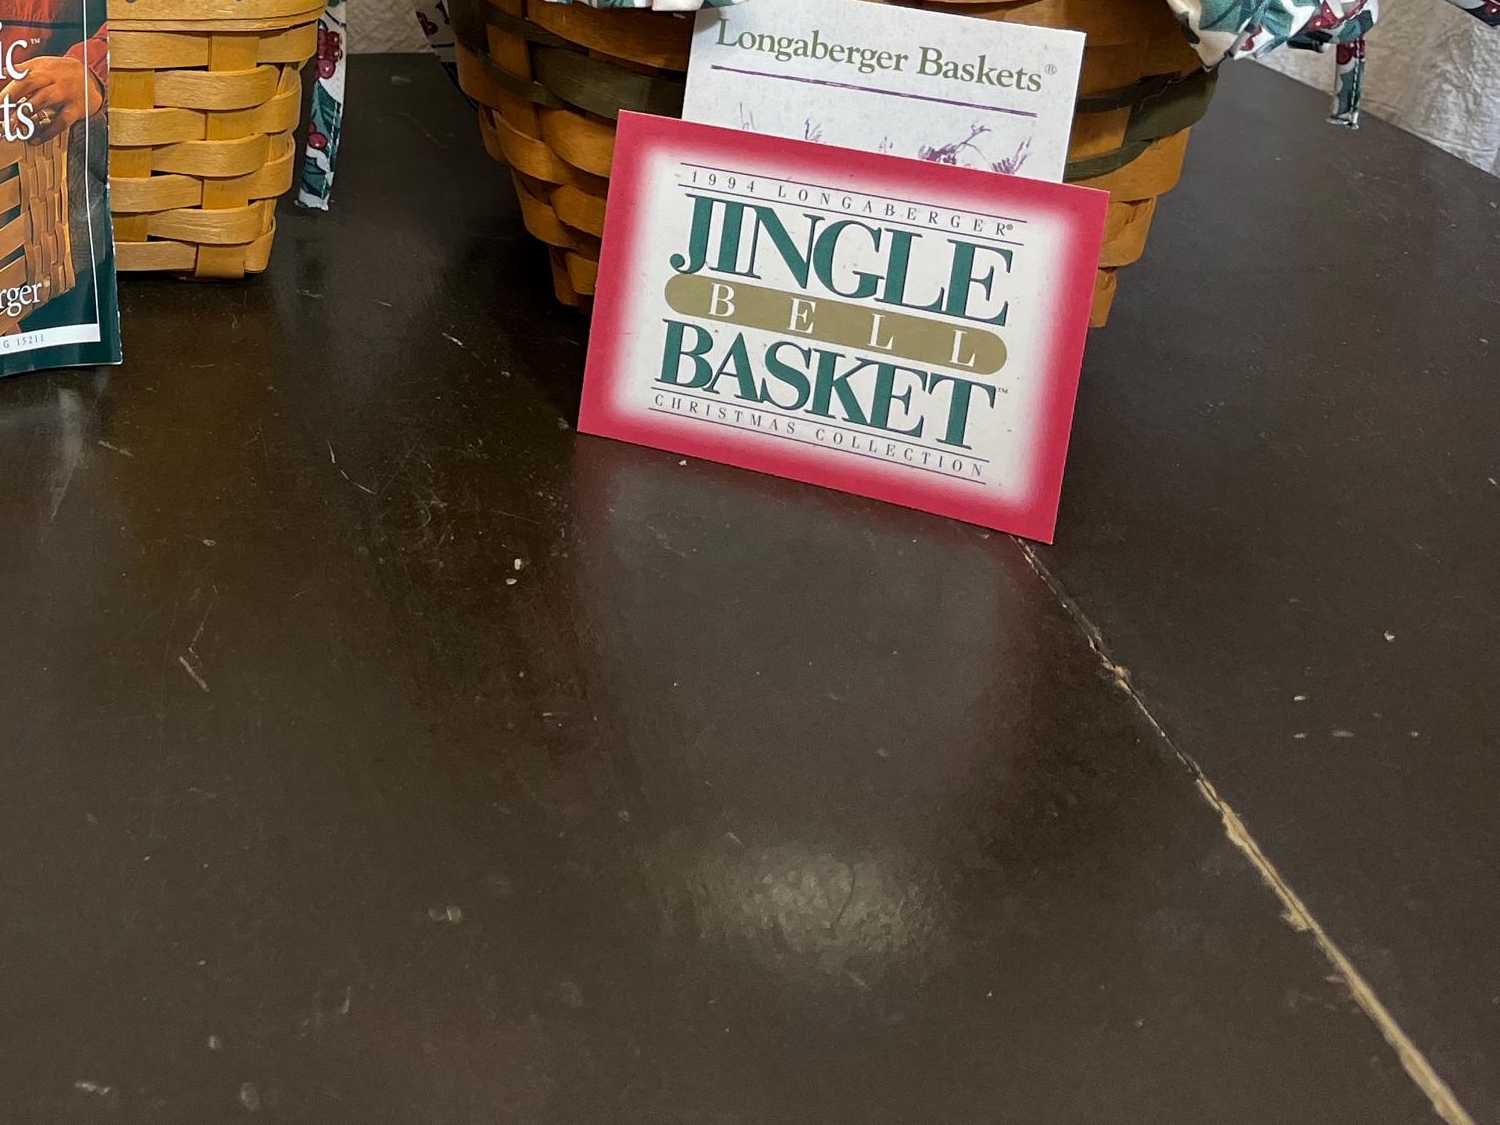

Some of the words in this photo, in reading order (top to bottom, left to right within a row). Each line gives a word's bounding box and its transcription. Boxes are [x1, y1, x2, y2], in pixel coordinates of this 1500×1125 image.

[714, 17, 909, 76] Longaberger
[691, 170, 756, 194] 1994
[668, 193, 1014, 327] JINGLE
[16, 334, 45, 347] 15211
[706, 282, 978, 369] BELL
[654, 393, 797, 435] CHRISTMAS
[815, 427, 985, 478] COLLECTION
